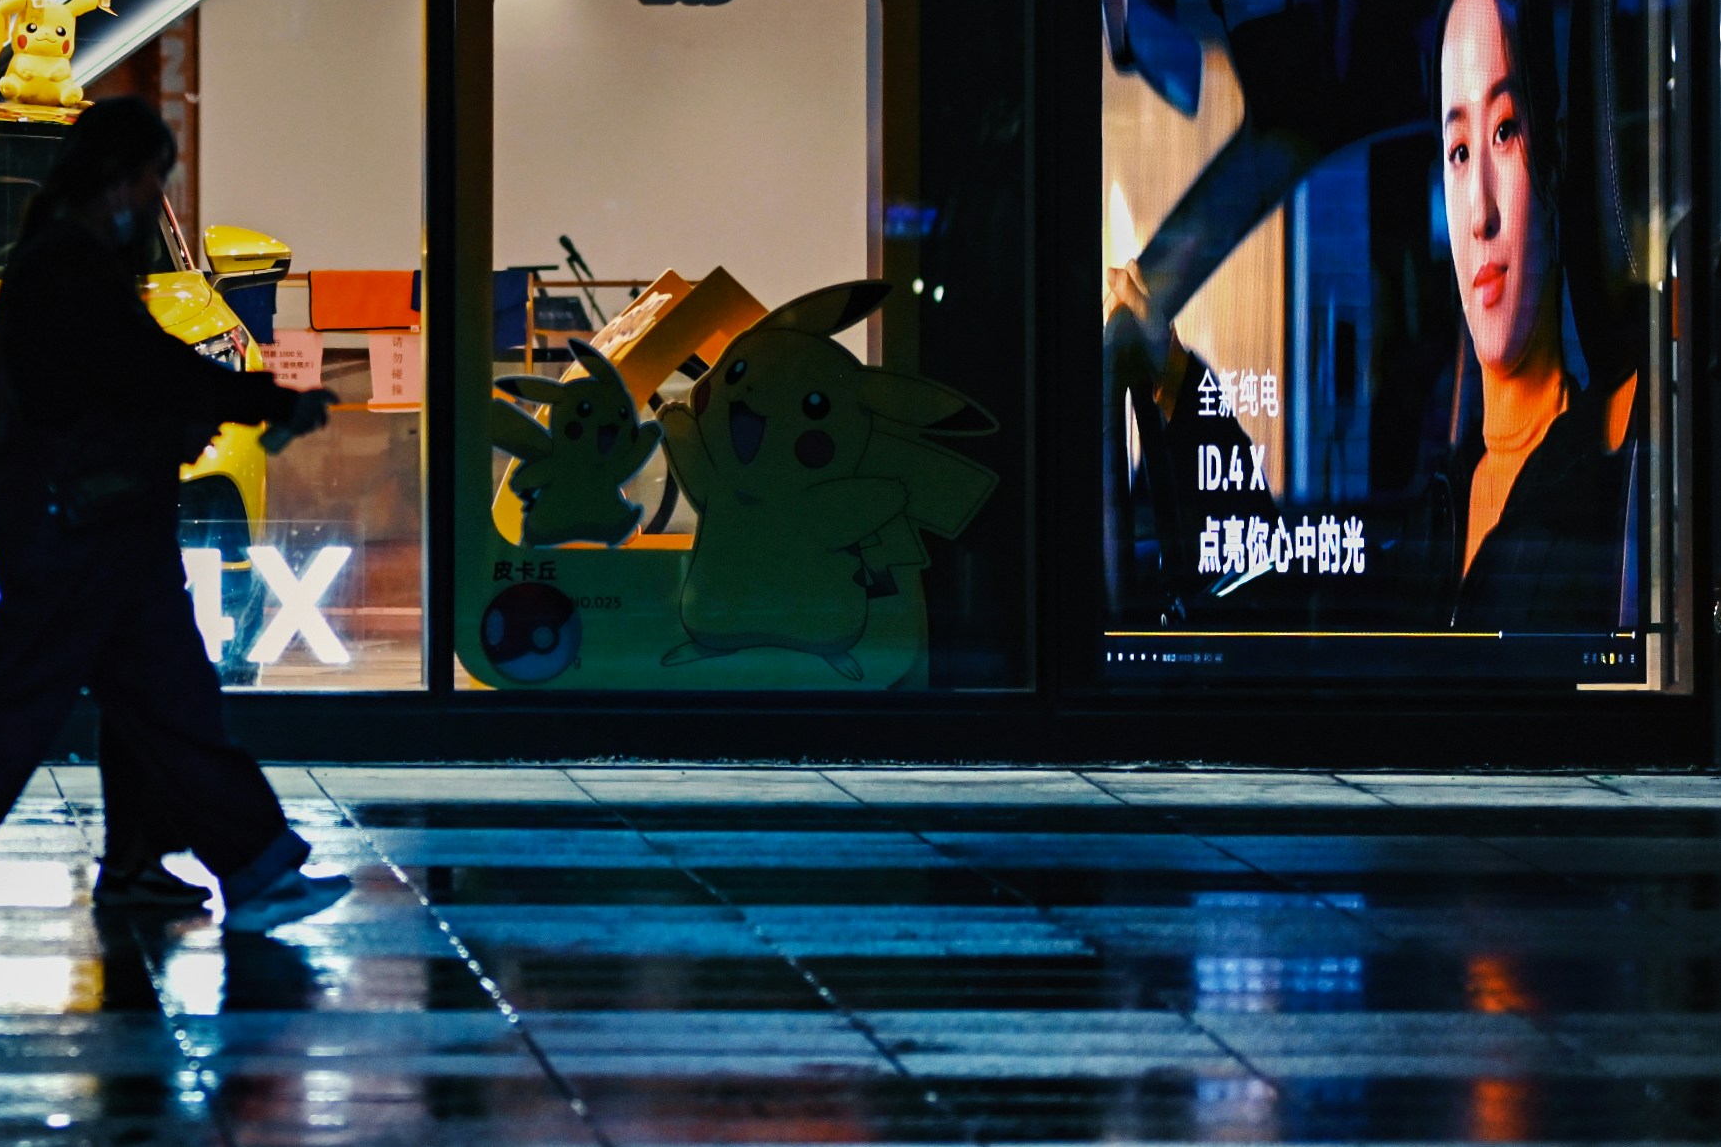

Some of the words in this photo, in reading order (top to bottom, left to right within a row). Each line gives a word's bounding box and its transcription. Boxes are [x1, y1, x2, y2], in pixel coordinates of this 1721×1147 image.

[1198, 368, 1279, 417] 全新纯电
[1198, 444, 1243, 491] ID.4
[1250, 444, 1265, 491] X
[1198, 515, 1365, 574] 点亮你心中的光
[493, 560, 557, 581] 皮卡丘
